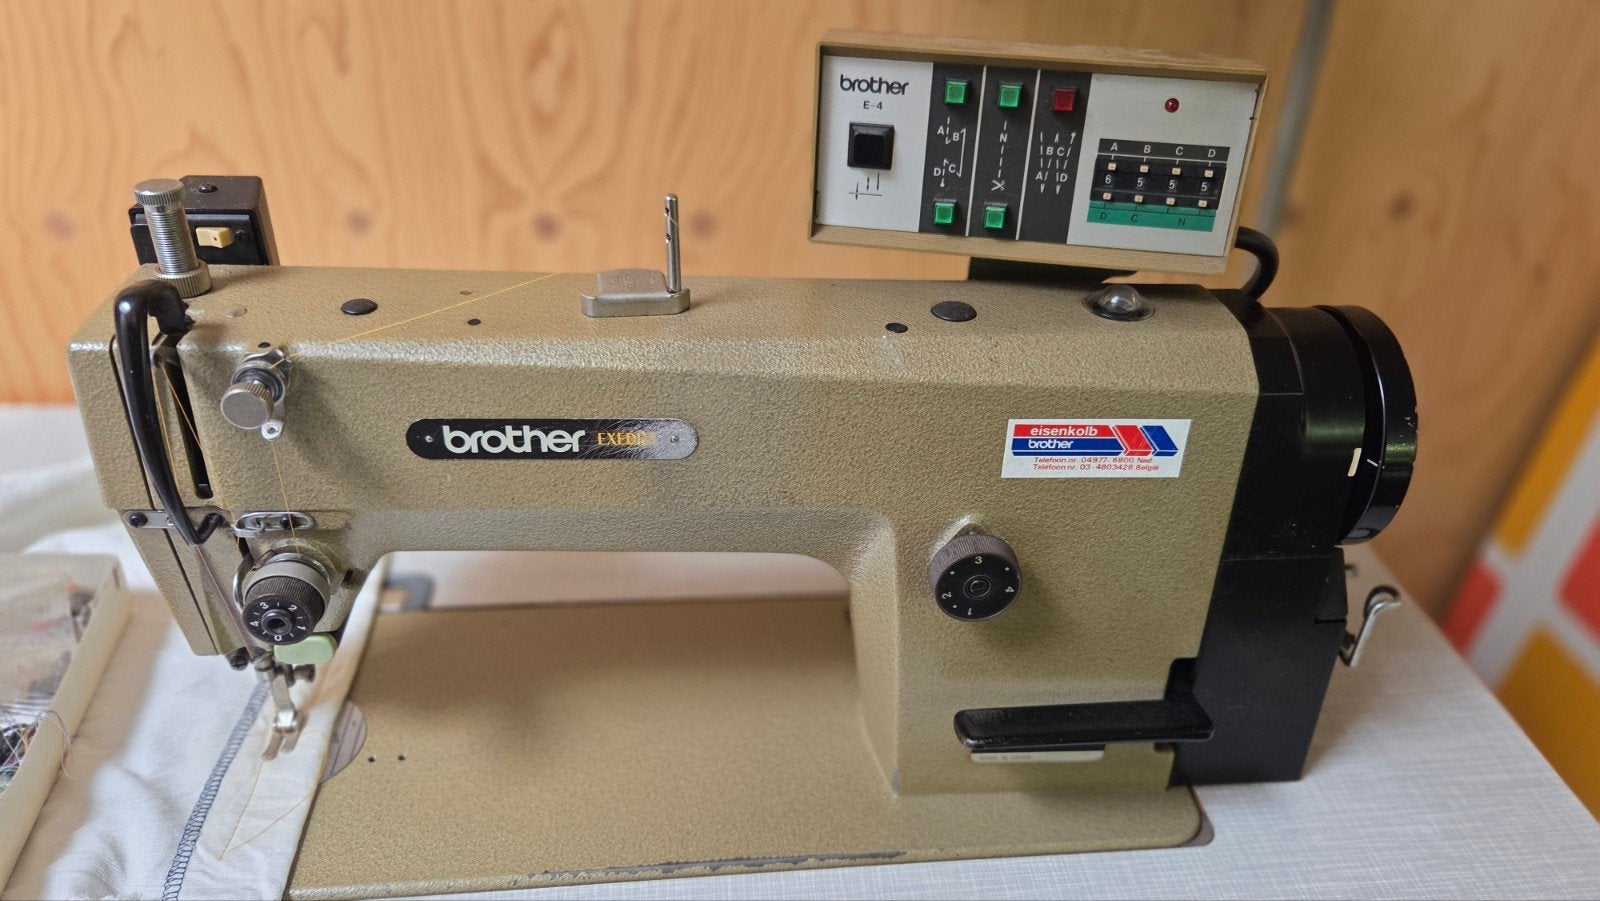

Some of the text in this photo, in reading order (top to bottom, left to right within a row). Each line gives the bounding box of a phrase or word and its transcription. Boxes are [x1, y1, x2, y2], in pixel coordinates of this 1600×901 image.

[840, 74, 909, 95] brother
[863, 100, 883, 110] E-4
[937, 126, 960, 141] A B
[1000, 134, 1007, 142] N
[1046, 147, 1065, 156] B C
[1110, 142, 1216, 158] A B C D
[933, 164, 956, 176] D C
[1035, 173, 1068, 182] A D
[1105, 174, 1208, 191] 6 5 5 5
[1100, 212, 1187, 226] D C N
[1030, 425, 1098, 437] eisenkolb
[442, 425, 585, 453] brother
[1028, 438, 1074, 449] brother
[974, 556, 983, 564] 3
[941, 591, 952, 599] 2
[288, 604, 298, 612] 2
[967, 607, 973, 616] 1
[274, 634, 283, 642] 0
